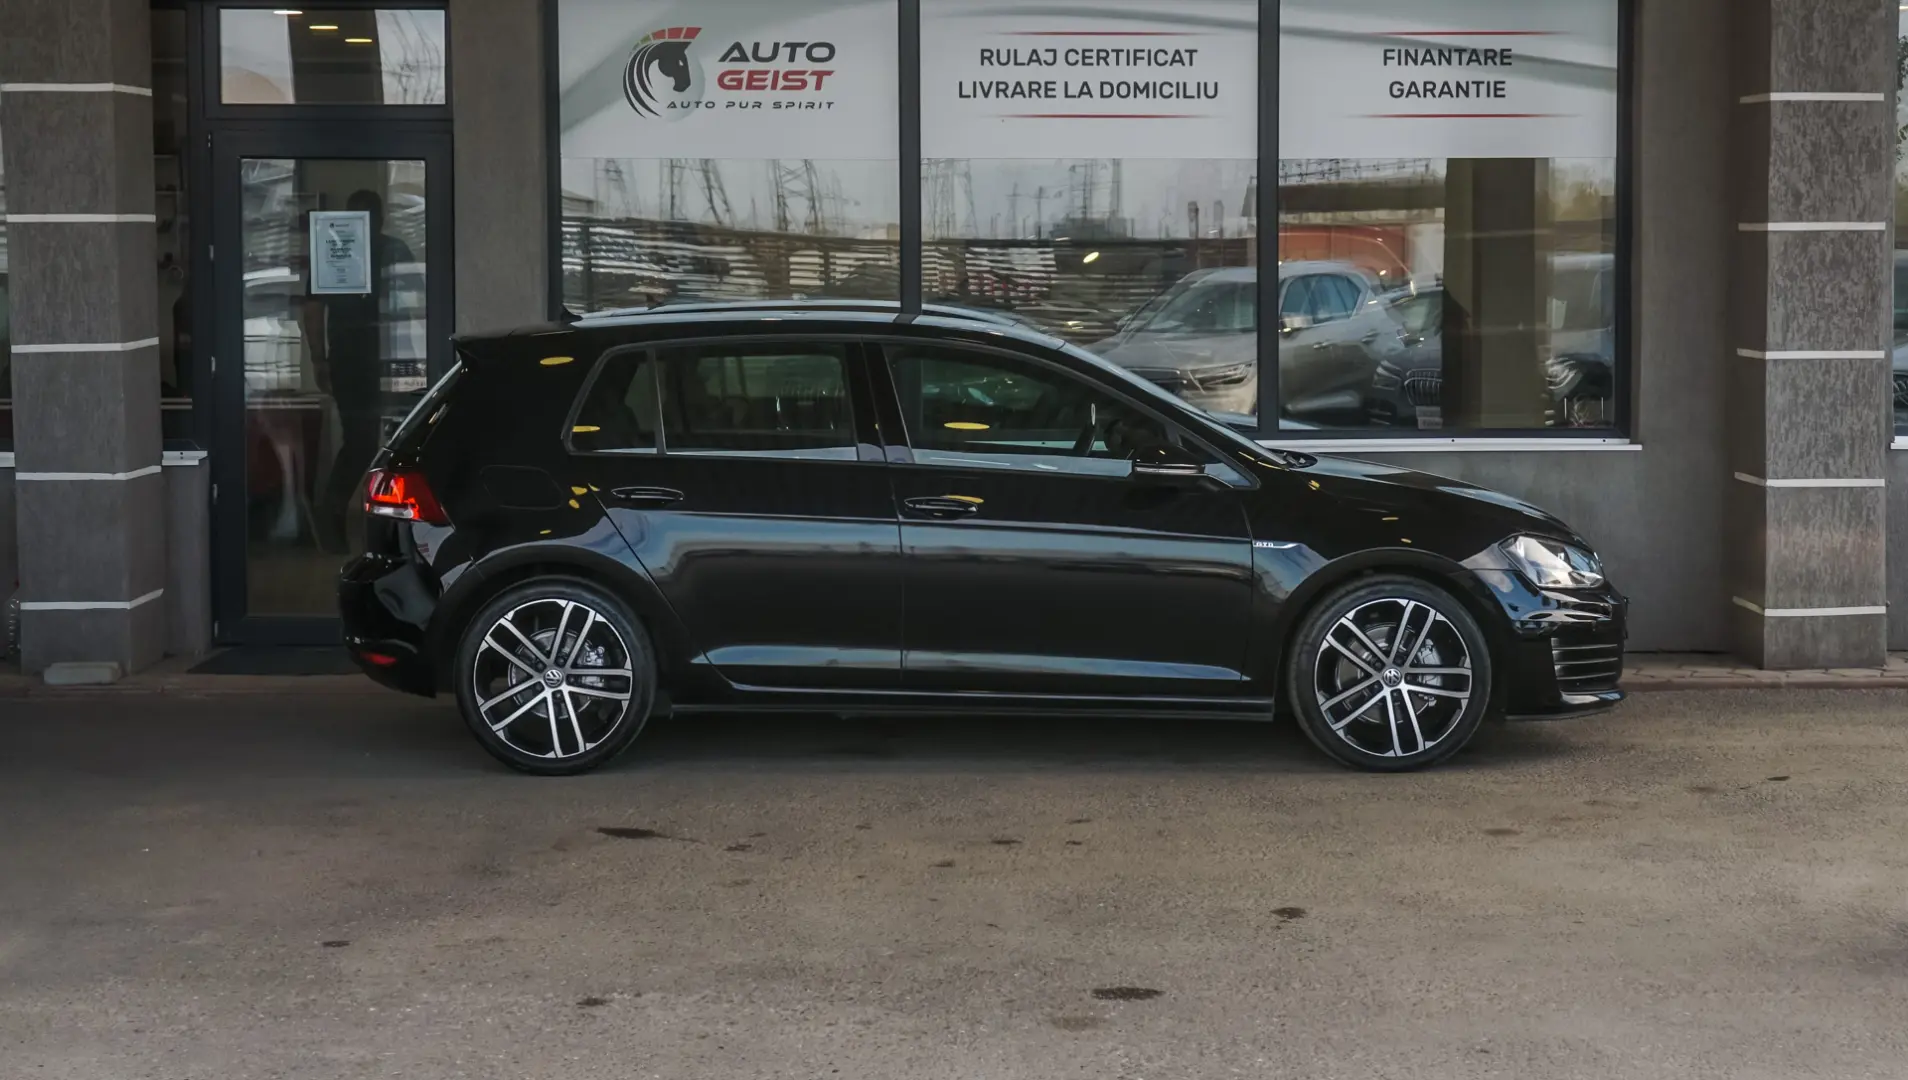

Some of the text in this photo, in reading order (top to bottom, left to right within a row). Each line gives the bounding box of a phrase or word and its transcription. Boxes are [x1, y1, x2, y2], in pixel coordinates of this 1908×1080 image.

[717, 41, 836, 63] AUTO
[980, 49, 1198, 66] RULAJ CERTIFICAT
[1383, 48, 1512, 66] FINANTARE
[717, 70, 835, 91] GEIST
[1389, 80, 1506, 98] GARANTIE
[958, 81, 1219, 99] LIVRARE LA DOMICILIU
[667, 101, 834, 109] AUTO PUR SPIRIT
